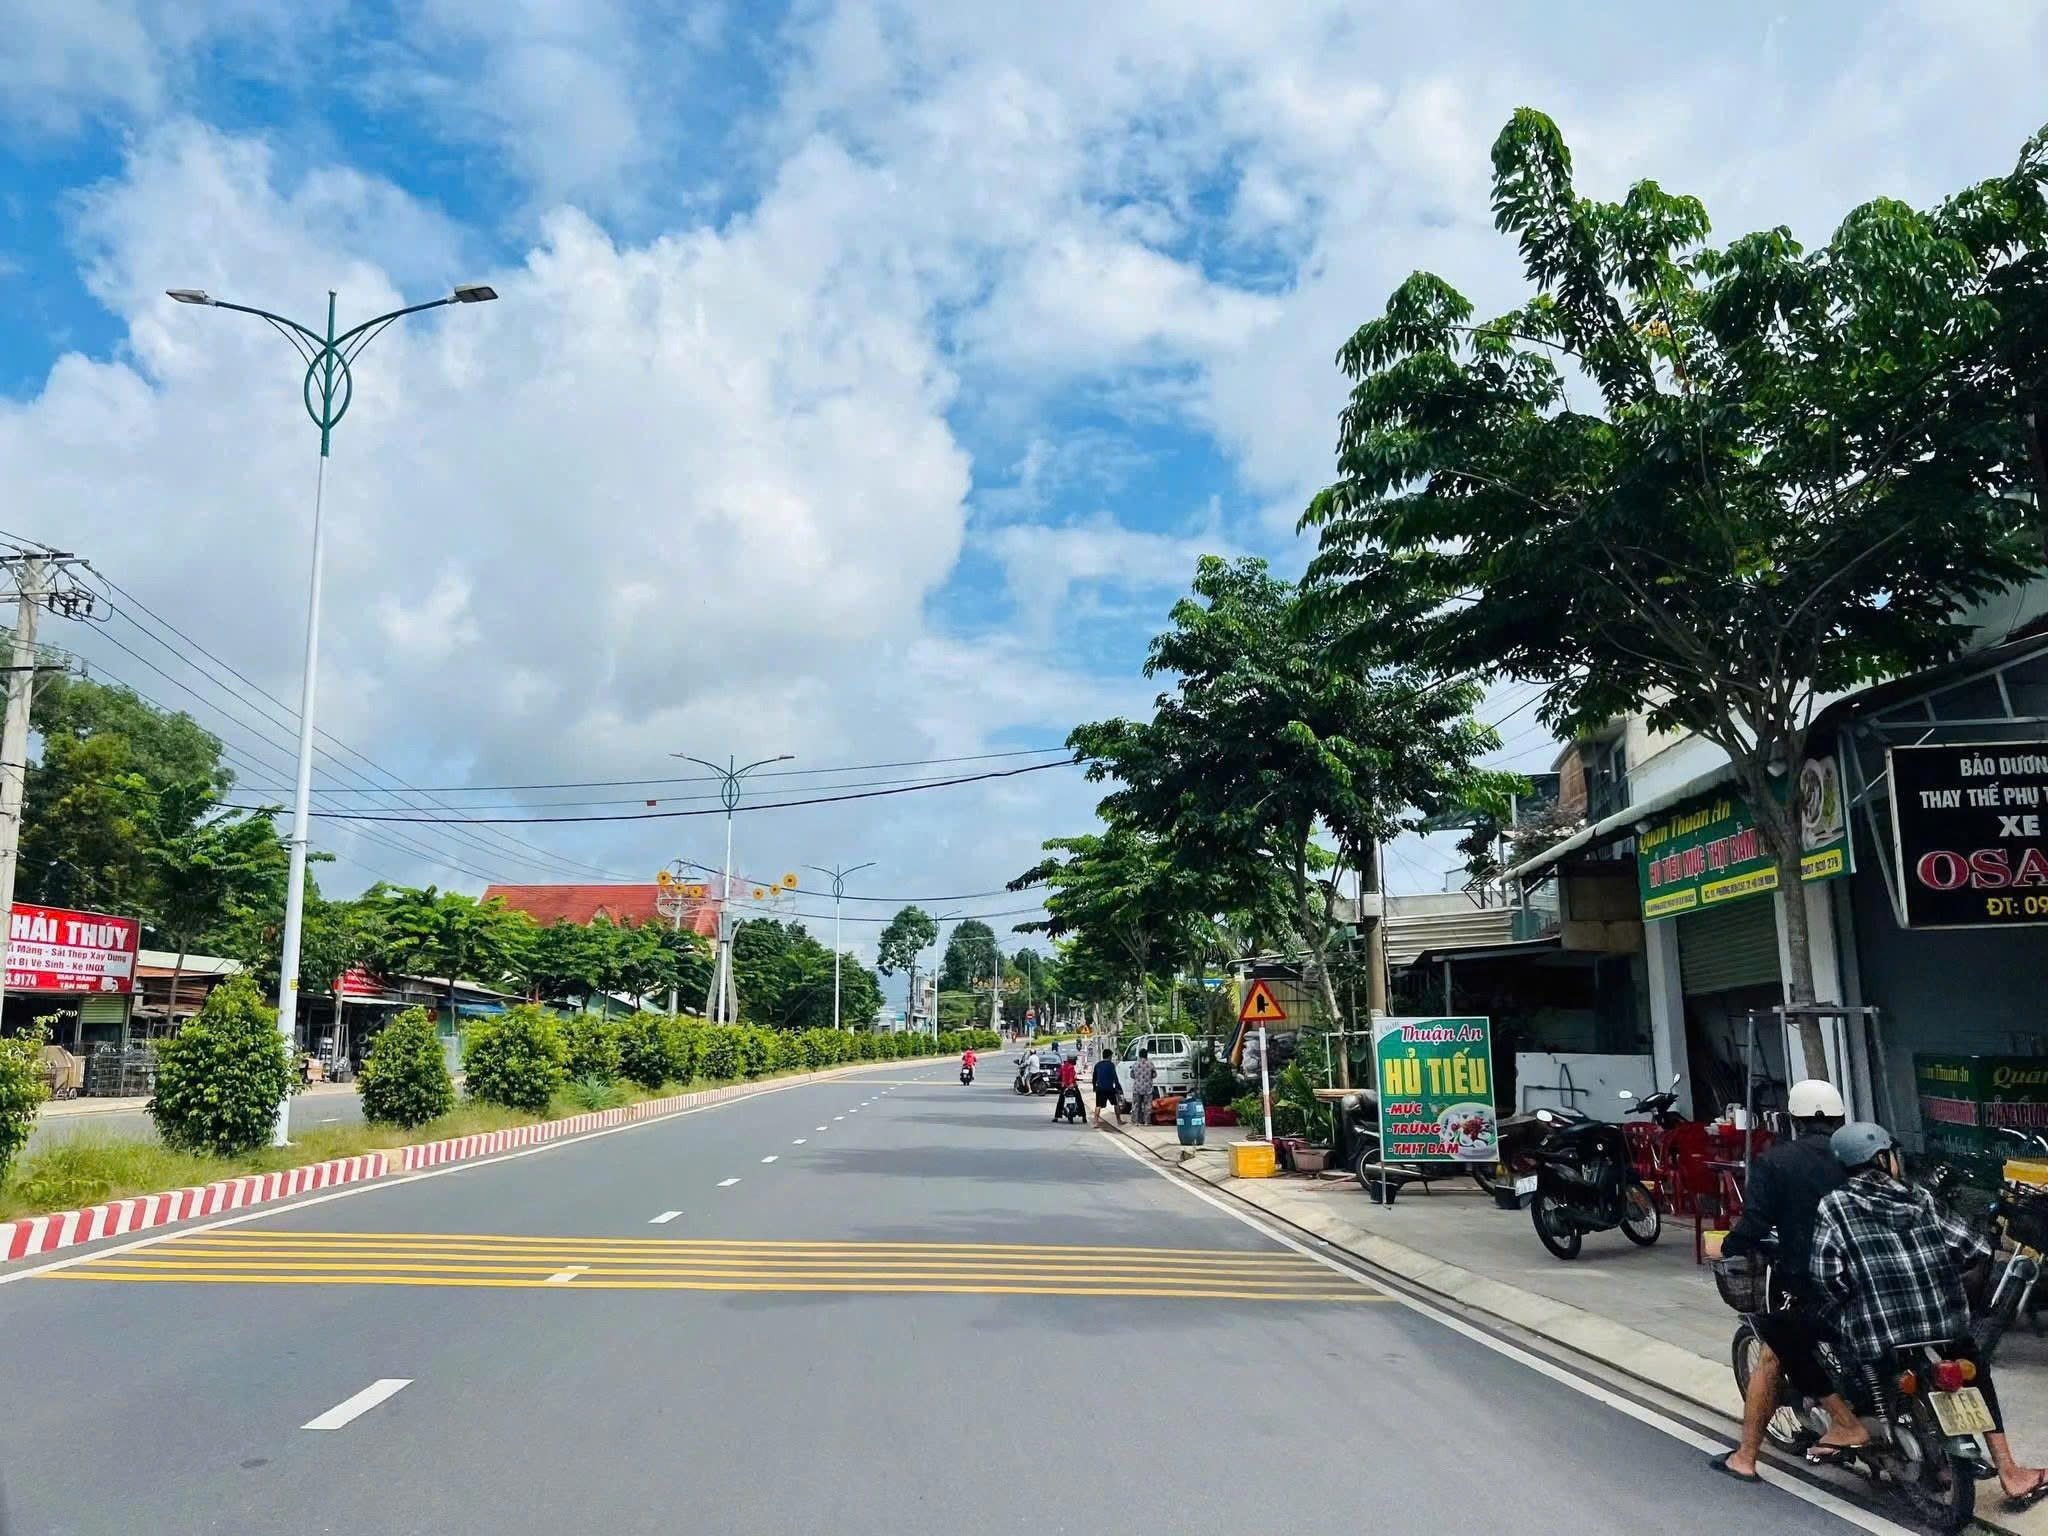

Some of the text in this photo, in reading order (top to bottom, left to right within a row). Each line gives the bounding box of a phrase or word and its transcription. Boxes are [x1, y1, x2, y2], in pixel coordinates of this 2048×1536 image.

[1960, 752, 1995, 776] BẢO
[1919, 788, 1961, 808] THAY
[1967, 781, 2000, 807] THẾ
[2003, 787, 2039, 809] PHỤ
[1998, 815, 2041, 837] XE
[1917, 848, 2048, 890] OSA
[1986, 897, 2019, 916] ĐT:
[11, 911, 129, 949] HẢI THÚY
[45, 959, 64, 970] Sinh
[85, 963, 105, 972] INOX
[1401, 1024, 1454, 1046] Thuận
[1457, 1024, 1484, 1042] An
[1384, 1047, 1488, 1096] HỦ TIẾU
